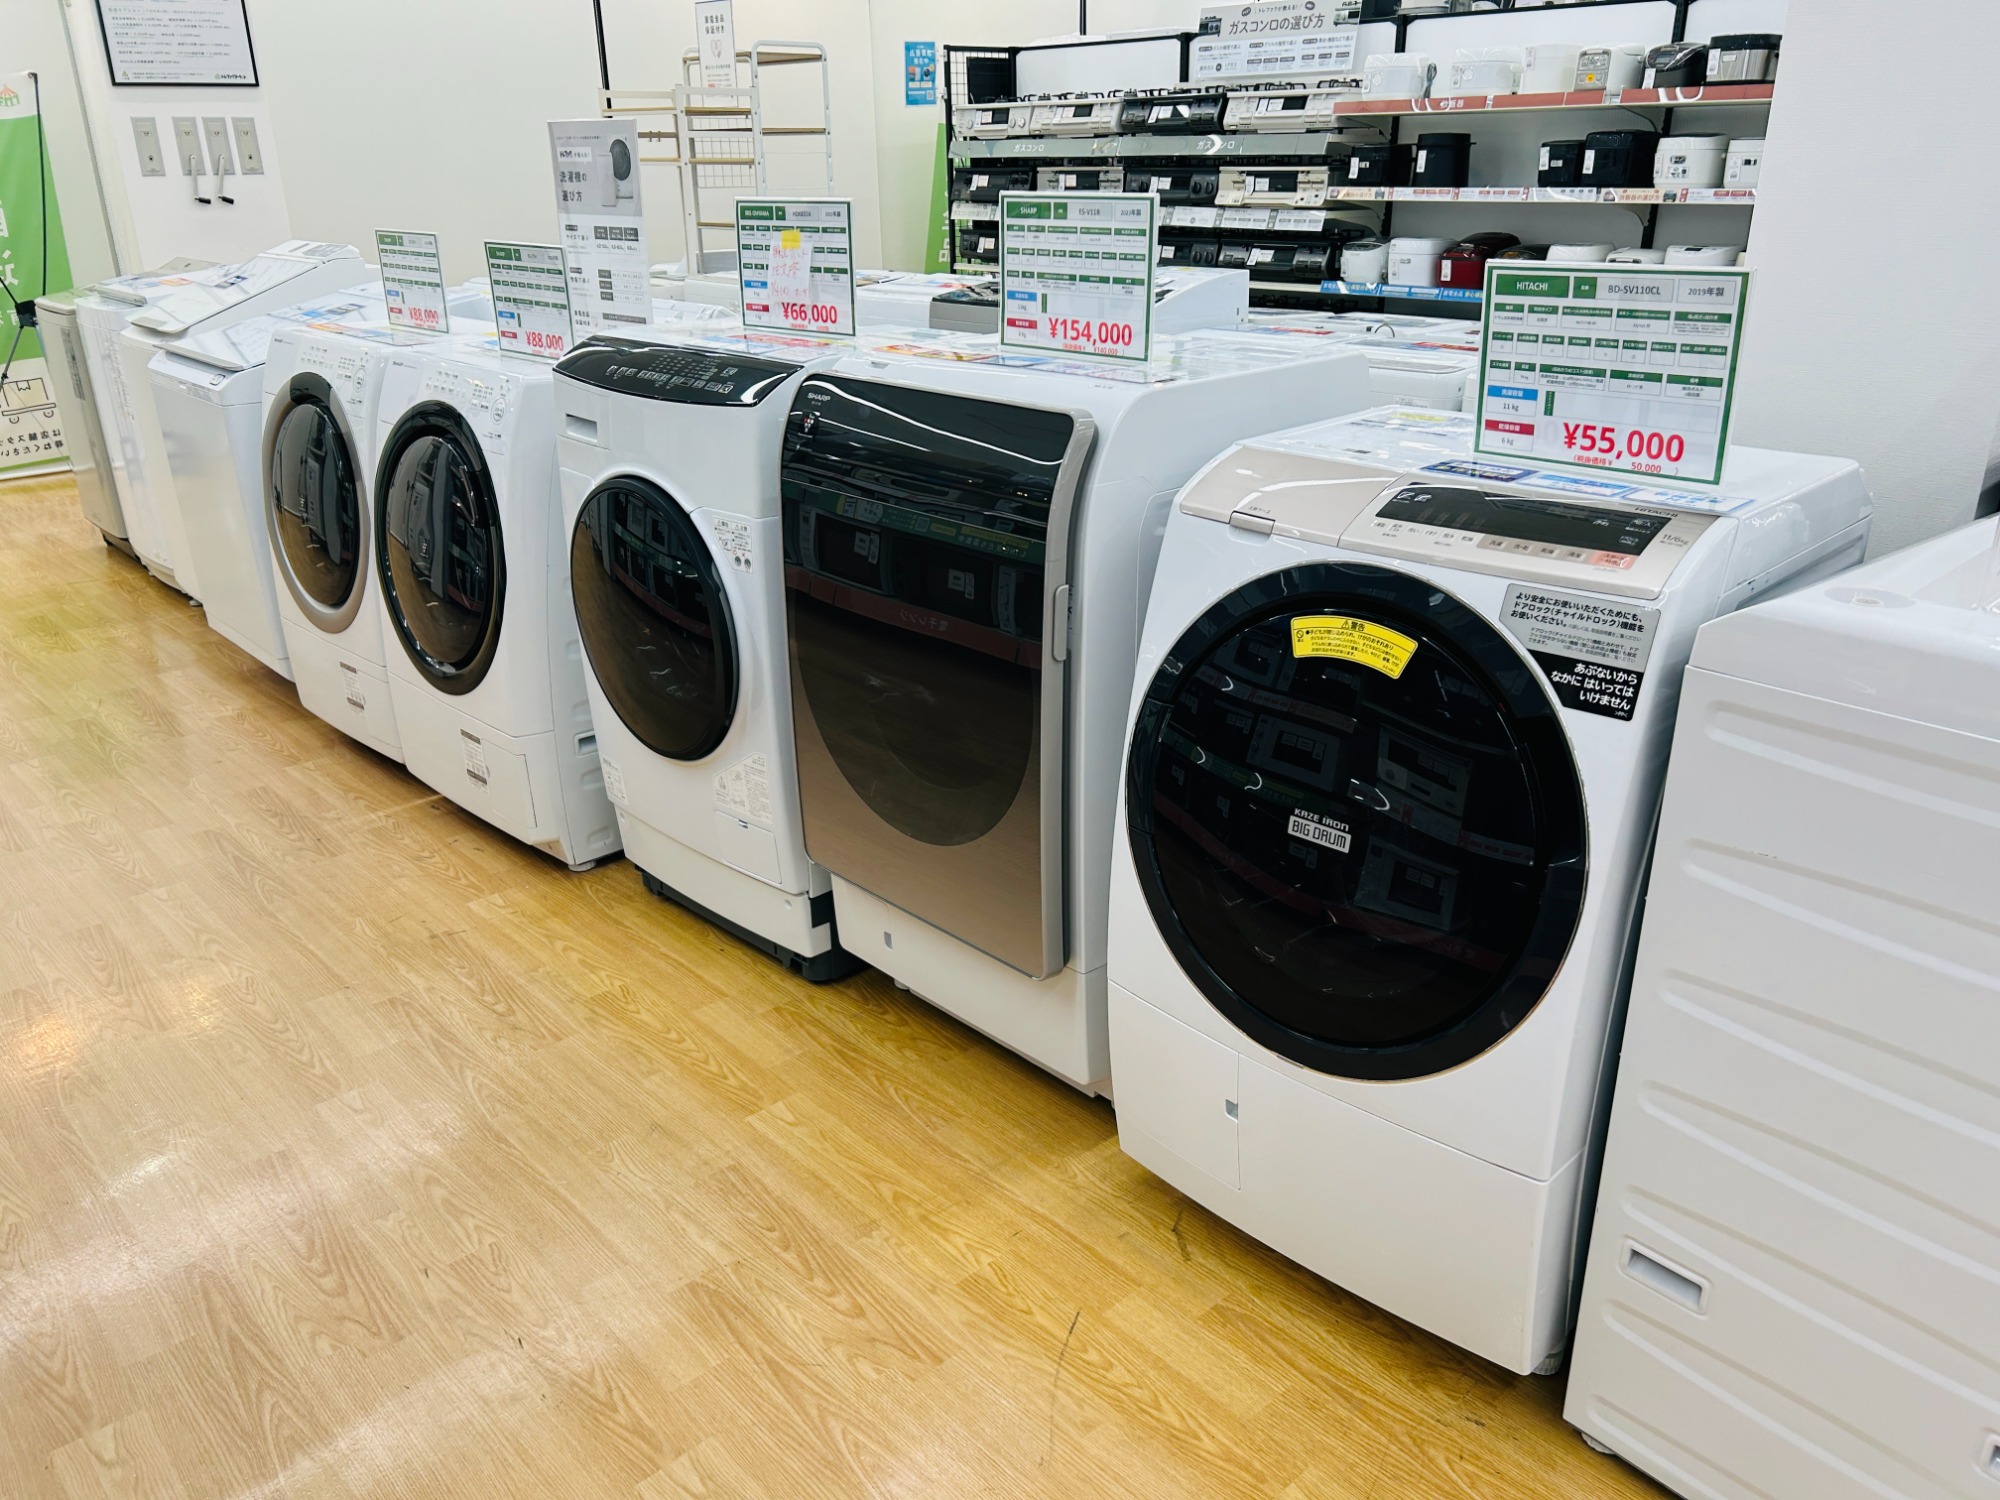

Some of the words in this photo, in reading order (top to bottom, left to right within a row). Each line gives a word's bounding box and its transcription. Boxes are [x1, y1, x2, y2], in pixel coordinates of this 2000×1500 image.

[1229, 13, 1325, 36] ガスコンロの選び方
[1013, 144, 1045, 152] ガスコンロ
[561, 190, 583, 202] 選び方
[1020, 206, 1038, 215] SHARP
[1516, 281, 1549, 291] HITACHI
[1607, 284, 1661, 296] BD-SV110CL
[1687, 286, 1725, 297] 2019年製
[408, 306, 439, 325] ¥88,000
[781, 302, 838, 324] ¥66,000
[525, 330, 564, 351] ¥88,000
[1048, 317, 1133, 347] ¥154,000
[807, 391, 831, 402] SHARP
[1511, 404, 1519, 412] kg
[1563, 422, 1685, 463] ¥55,000
[1631, 461, 1662, 474] 50,000
[1634, 507, 1679, 518] HITACHI
[1663, 533, 1690, 546] 11/6kg
[1514, 600, 1645, 633] ドアロック(チャイルドロック)機能を
[1515, 592, 1642, 623] より安全にお使いいただくためにも、
[1350, 621, 1366, 632] 警告
[1510, 609, 1568, 628] お使いください。
[1574, 662, 1638, 685] あぶないから
[1550, 670, 1582, 687] なかに
[1584, 677, 1635, 698] はいっては
[1579, 690, 1631, 711] いけません
[1294, 808, 1320, 822] KAZE
[1322, 815, 1349, 832] IRON
[1292, 820, 1311, 837] BIG
[1312, 826, 1347, 849] DRUM
